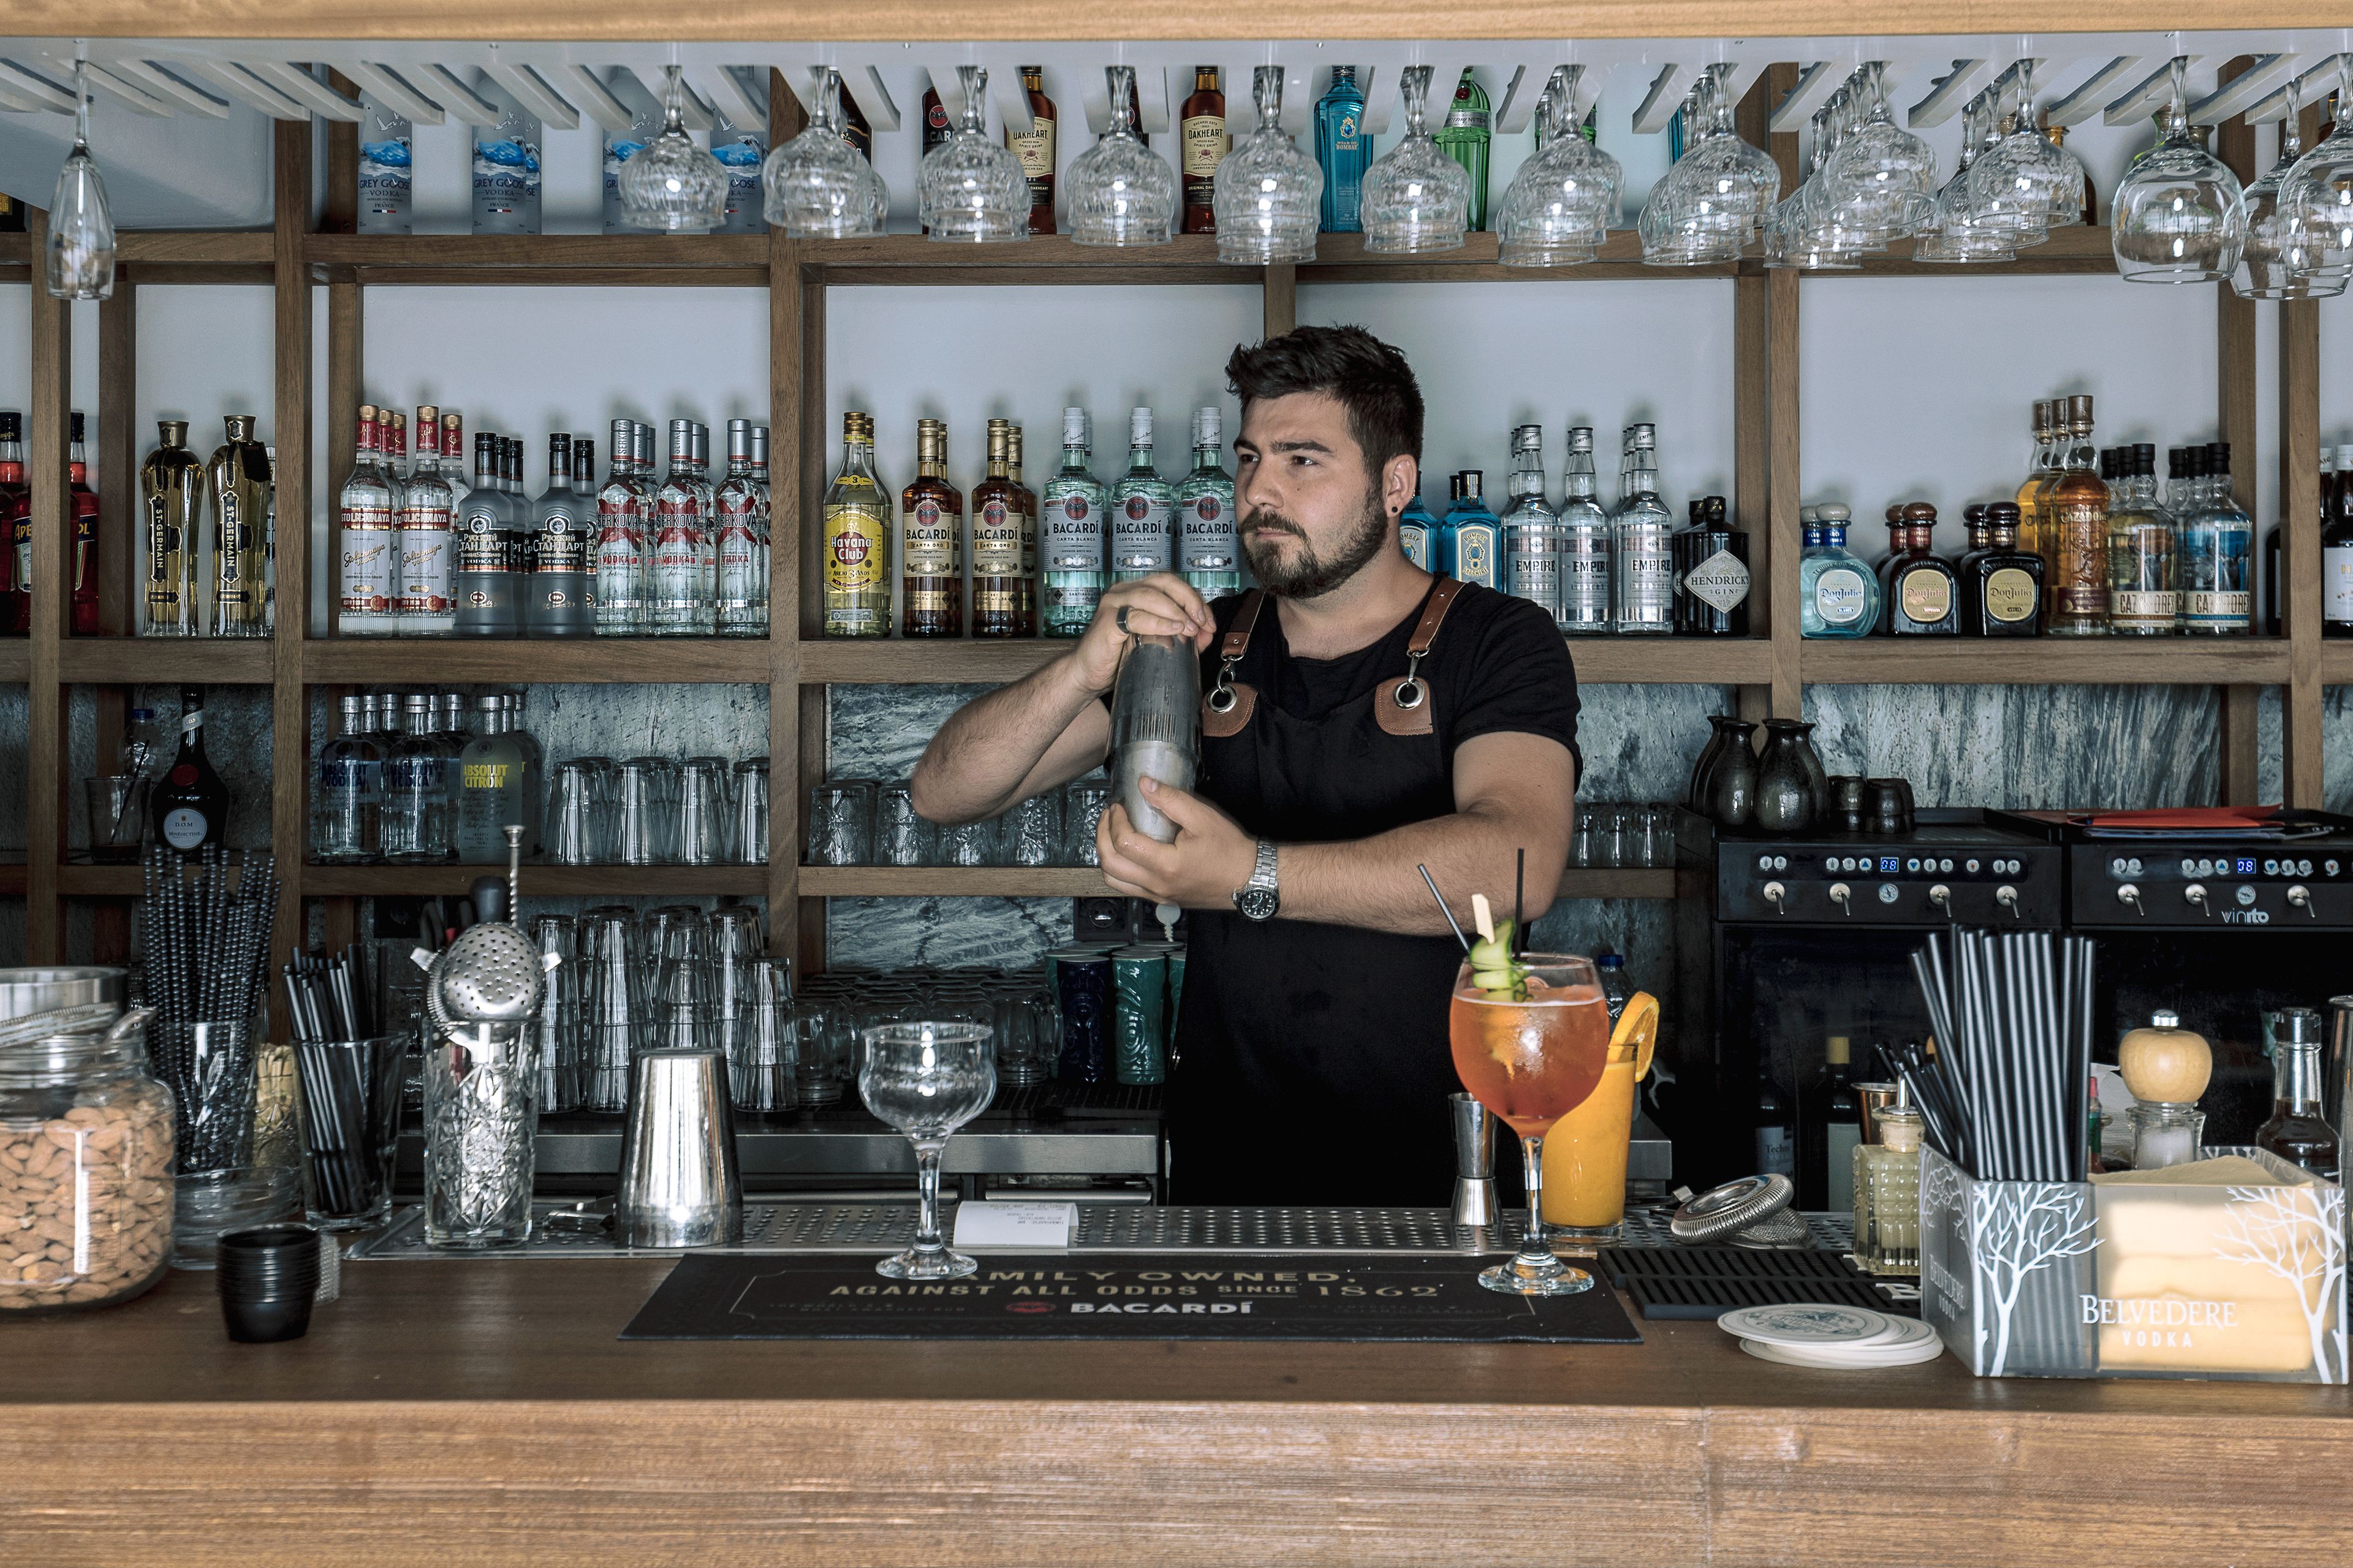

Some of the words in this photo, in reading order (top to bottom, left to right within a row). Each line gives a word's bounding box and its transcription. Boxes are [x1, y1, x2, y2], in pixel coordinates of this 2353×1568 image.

[1188, 128, 1224, 140] OAKHEART
[359, 179, 379, 188] GREY
[381, 179, 410, 191] GOOSE
[474, 178, 494, 188] GREY
[730, 179, 756, 189] OOSE
[618, 421, 627, 455] SERKOVA
[341, 513, 390, 523] STOLICHNAYA
[401, 513, 447, 523] TOLICHNAYA
[597, 513, 638, 528] SERKOVA
[656, 513, 698, 528] SERKOVA
[716, 513, 756, 528] SERKOVA
[906, 526, 950, 540] BACARDÍ
[974, 526, 1018, 540] BACARDÍ
[1053, 520, 1099, 534] BACARDÍ
[1116, 520, 1162, 534] BACARDÍ
[1186, 520, 1233, 534] BACARDÍ
[226, 506, 235, 567] ST-GERMAIN
[831, 536, 873, 548] Havana
[1400, 532, 1420, 543] OMBAY
[1463, 532, 1488, 545] BOMBAY
[344, 544, 386, 567] Stolichnaya
[402, 543, 442, 567] Stolichnaya
[838, 548, 863, 560] Club
[1516, 559, 1556, 572] EMPIRE
[1632, 559, 1671, 571] EMPIRE
[849, 569, 855, 578] 3
[1691, 575, 1749, 586] HENDRICK'S
[1821, 588, 1840, 599] Don
[1837, 588, 1862, 601] Julio
[1906, 588, 1925, 599] Don
[1922, 588, 1947, 601] Julio
[1990, 588, 2010, 597] Don
[2007, 588, 2032, 600] Julio
[2120, 594, 2175, 614] CAZADORES
[2196, 594, 2249, 614] CAZADORES
[464, 776, 504, 788] CITRON
[1881, 859, 1897, 871] 08
[1137, 1272, 1355, 1284] OWNED,
[828, 1285, 996, 1295] AGAINST
[1011, 1285, 1078, 1295] ALL
[1096, 1285, 1199, 1296] ODDS
[1217, 1284, 1297, 1294] SINCE
[1319, 1285, 1439, 1297] 1862
[1070, 1301, 1253, 1314] BACARDÍ
[2079, 1293, 2239, 1331] BELVEDERE
[2122, 1331, 2193, 1348] VODKA
